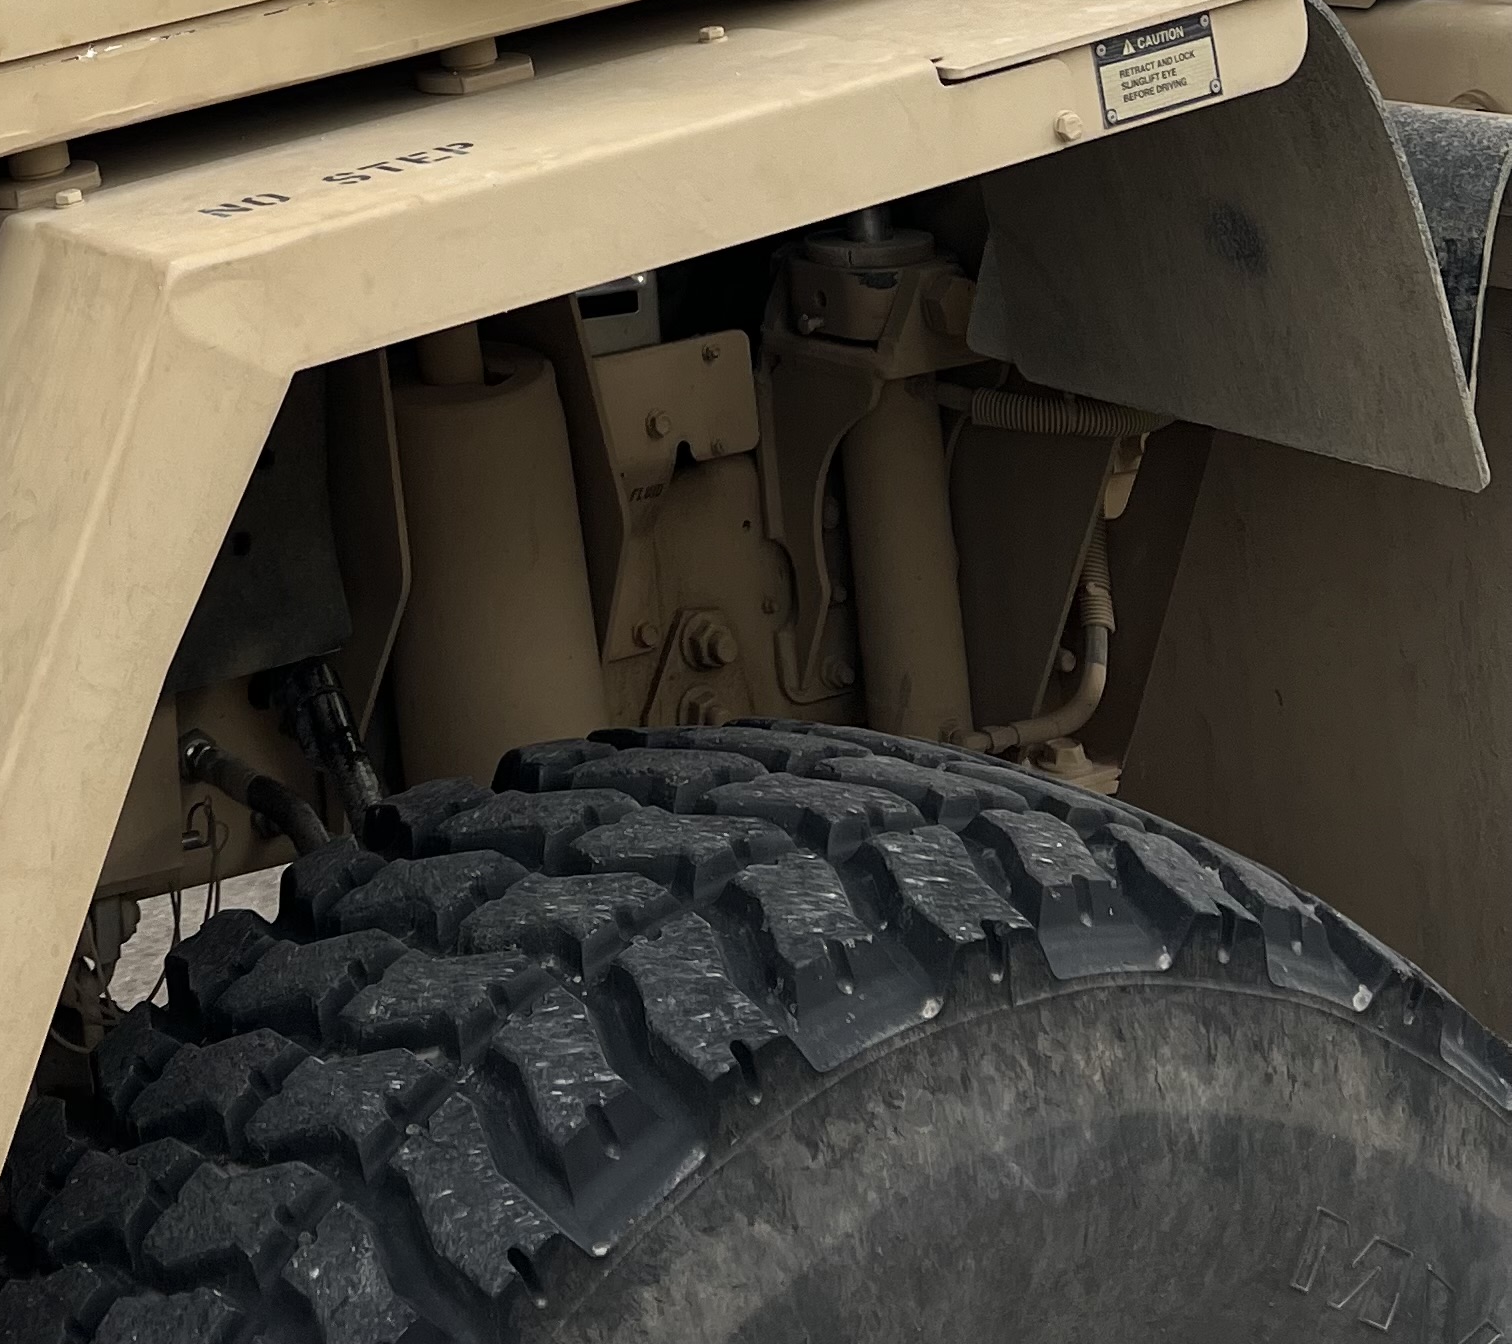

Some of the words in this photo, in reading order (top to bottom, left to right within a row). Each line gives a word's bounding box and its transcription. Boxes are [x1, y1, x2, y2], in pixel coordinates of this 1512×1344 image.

[1137, 26, 1185, 49] CAUTION
[1119, 60, 1155, 79] RETRACT
[1157, 55, 1173, 68] AND
[1174, 50, 1196, 63] LOCK
[1161, 67, 1178, 80] EYE
[1123, 86, 1155, 103] BEFORE
[1156, 76, 1188, 94] DRIVING
[197, 193, 291, 218] NO
[322, 142, 474, 185] STEP
